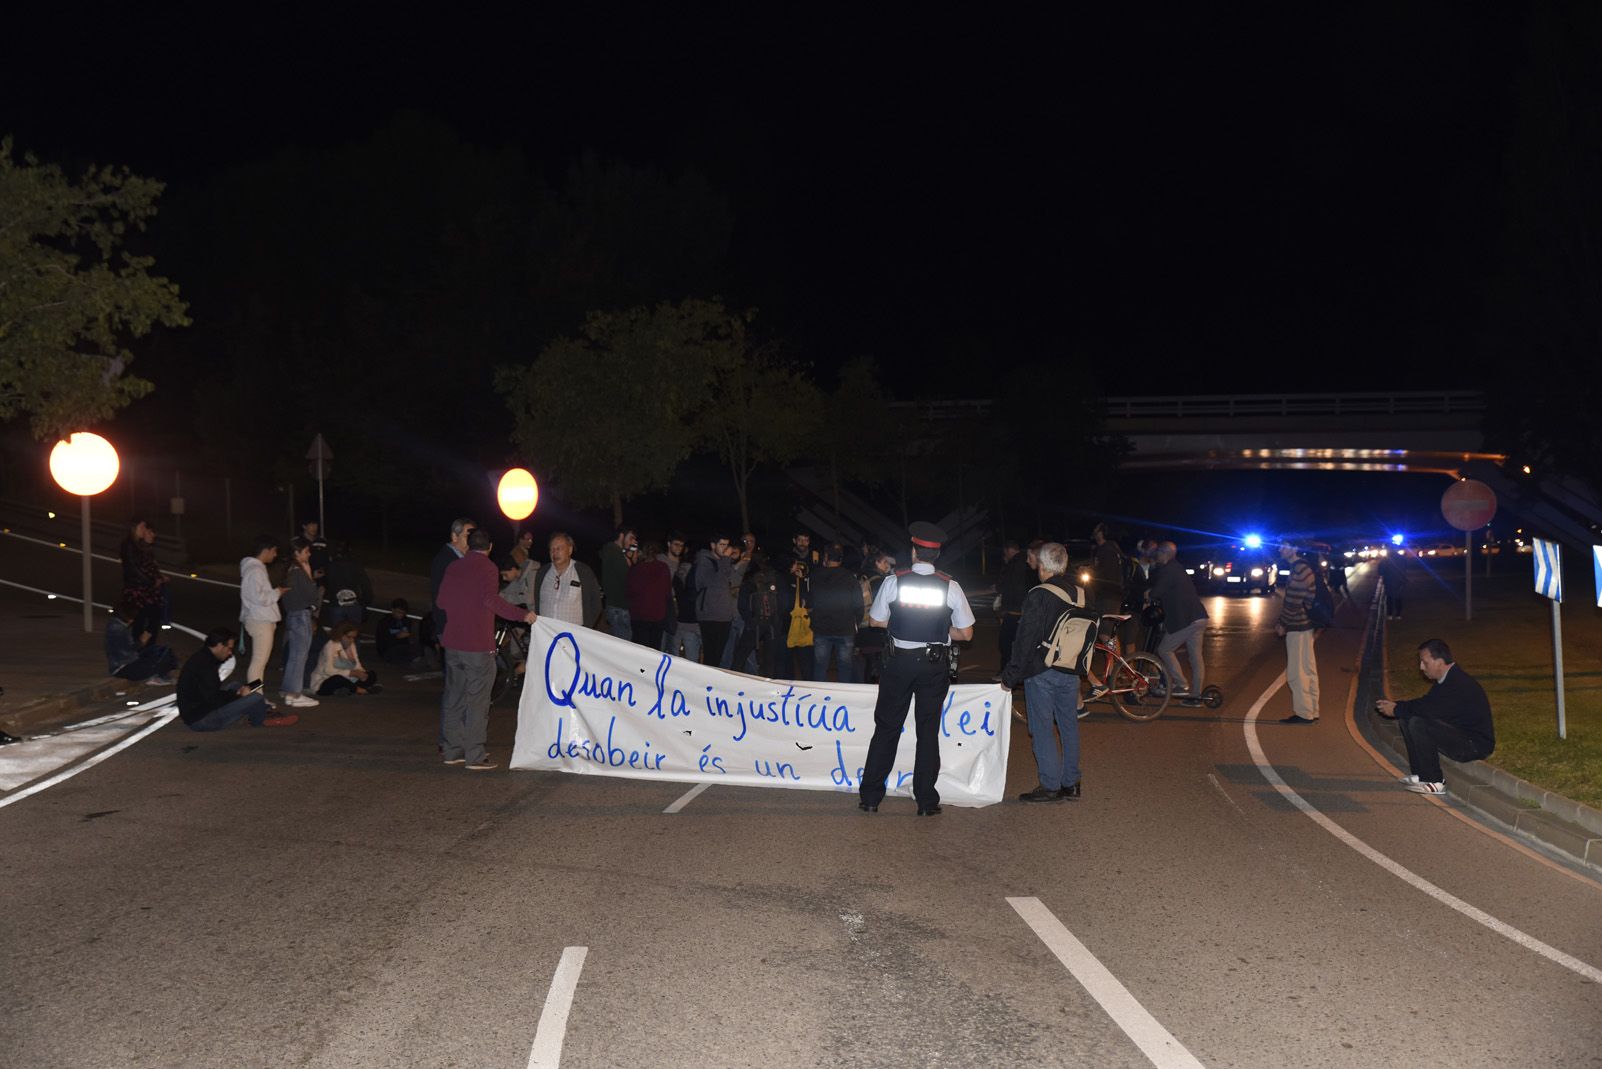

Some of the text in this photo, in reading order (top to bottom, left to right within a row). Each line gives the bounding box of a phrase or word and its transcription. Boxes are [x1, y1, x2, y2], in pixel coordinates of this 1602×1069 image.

[545, 631, 637, 709] Quan
[648, 654, 691, 720] la
[705, 685, 856, 742] injustícia
[547, 715, 667, 771] desobeir
[699, 743, 727, 774] és
[755, 759, 801, 781] un
